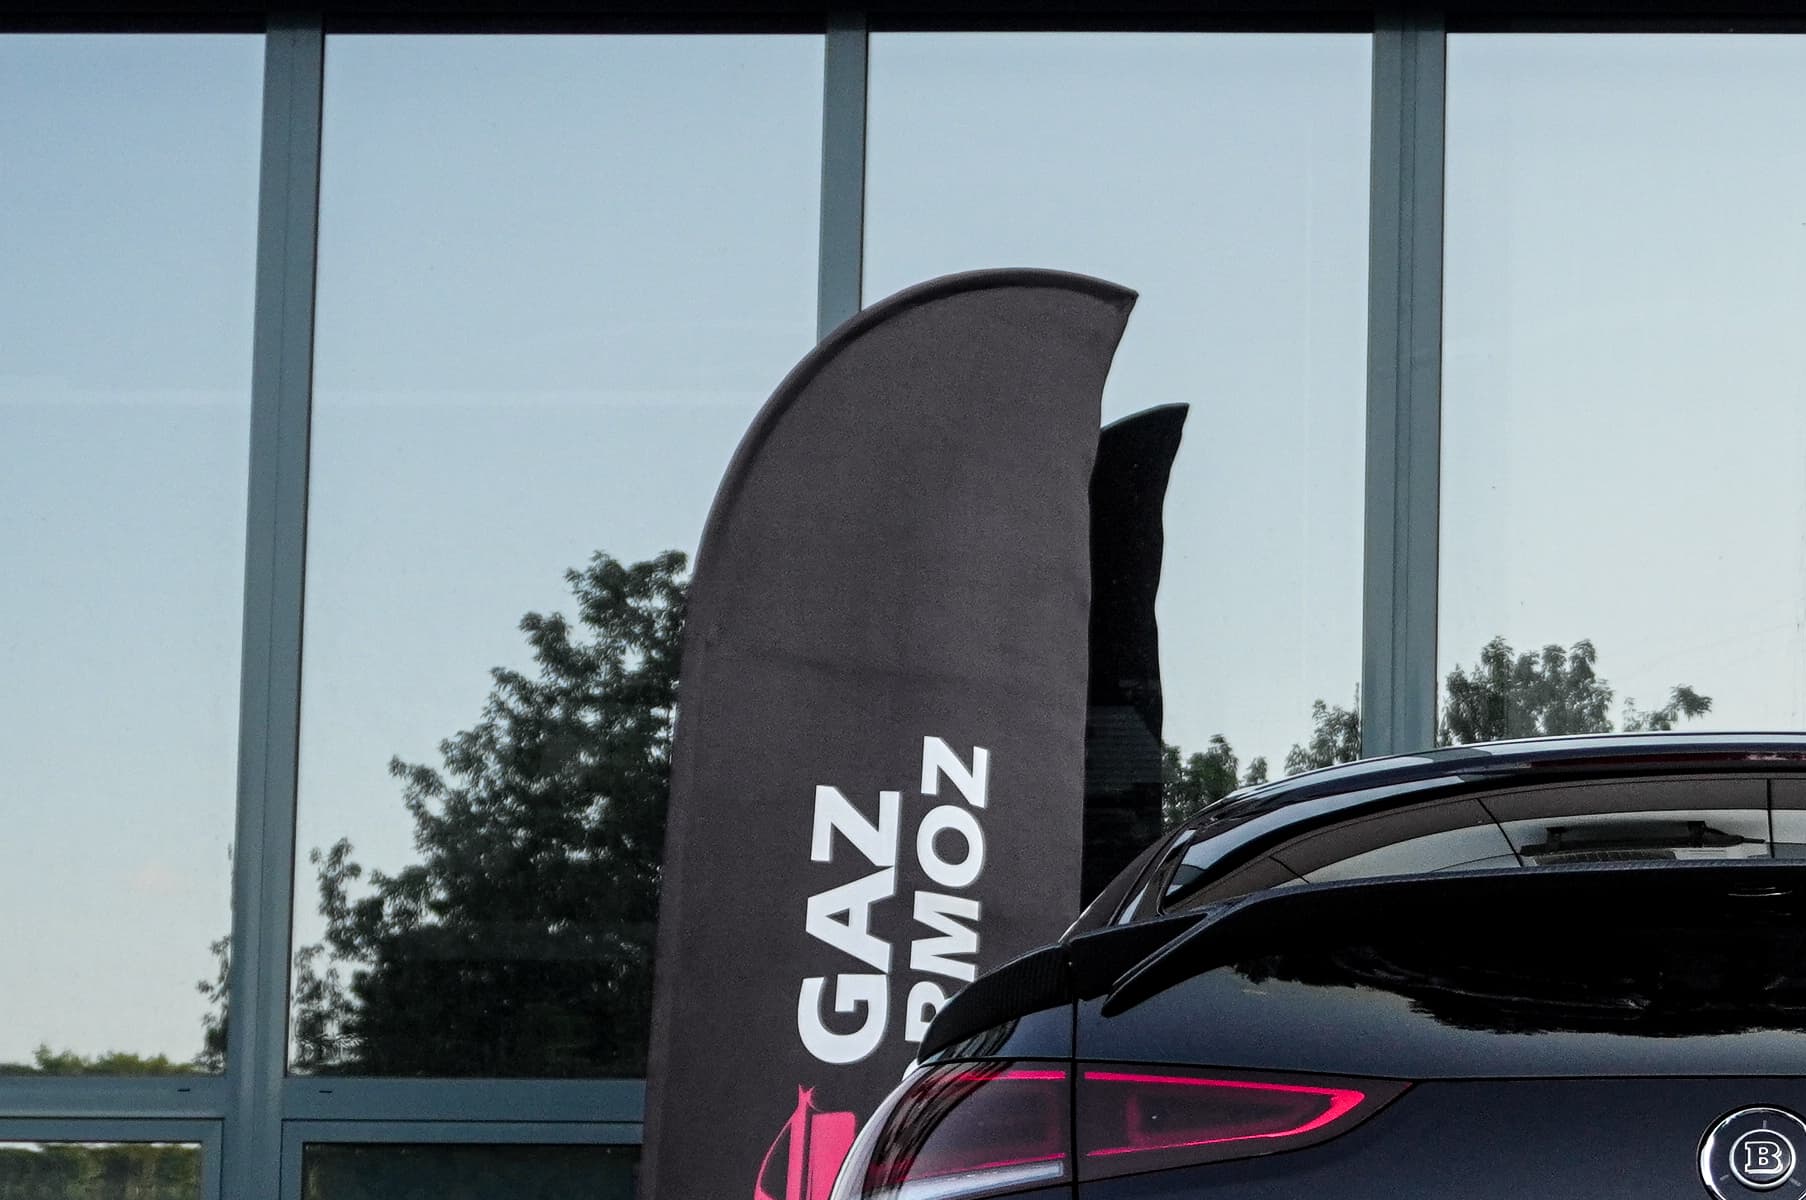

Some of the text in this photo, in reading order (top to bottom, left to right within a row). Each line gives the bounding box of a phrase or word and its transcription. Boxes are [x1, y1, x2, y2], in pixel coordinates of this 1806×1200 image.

[797, 784, 901, 1065] GAZ
[900, 735, 991, 1082] RMOZ
[1744, 1141, 1783, 1174] B
